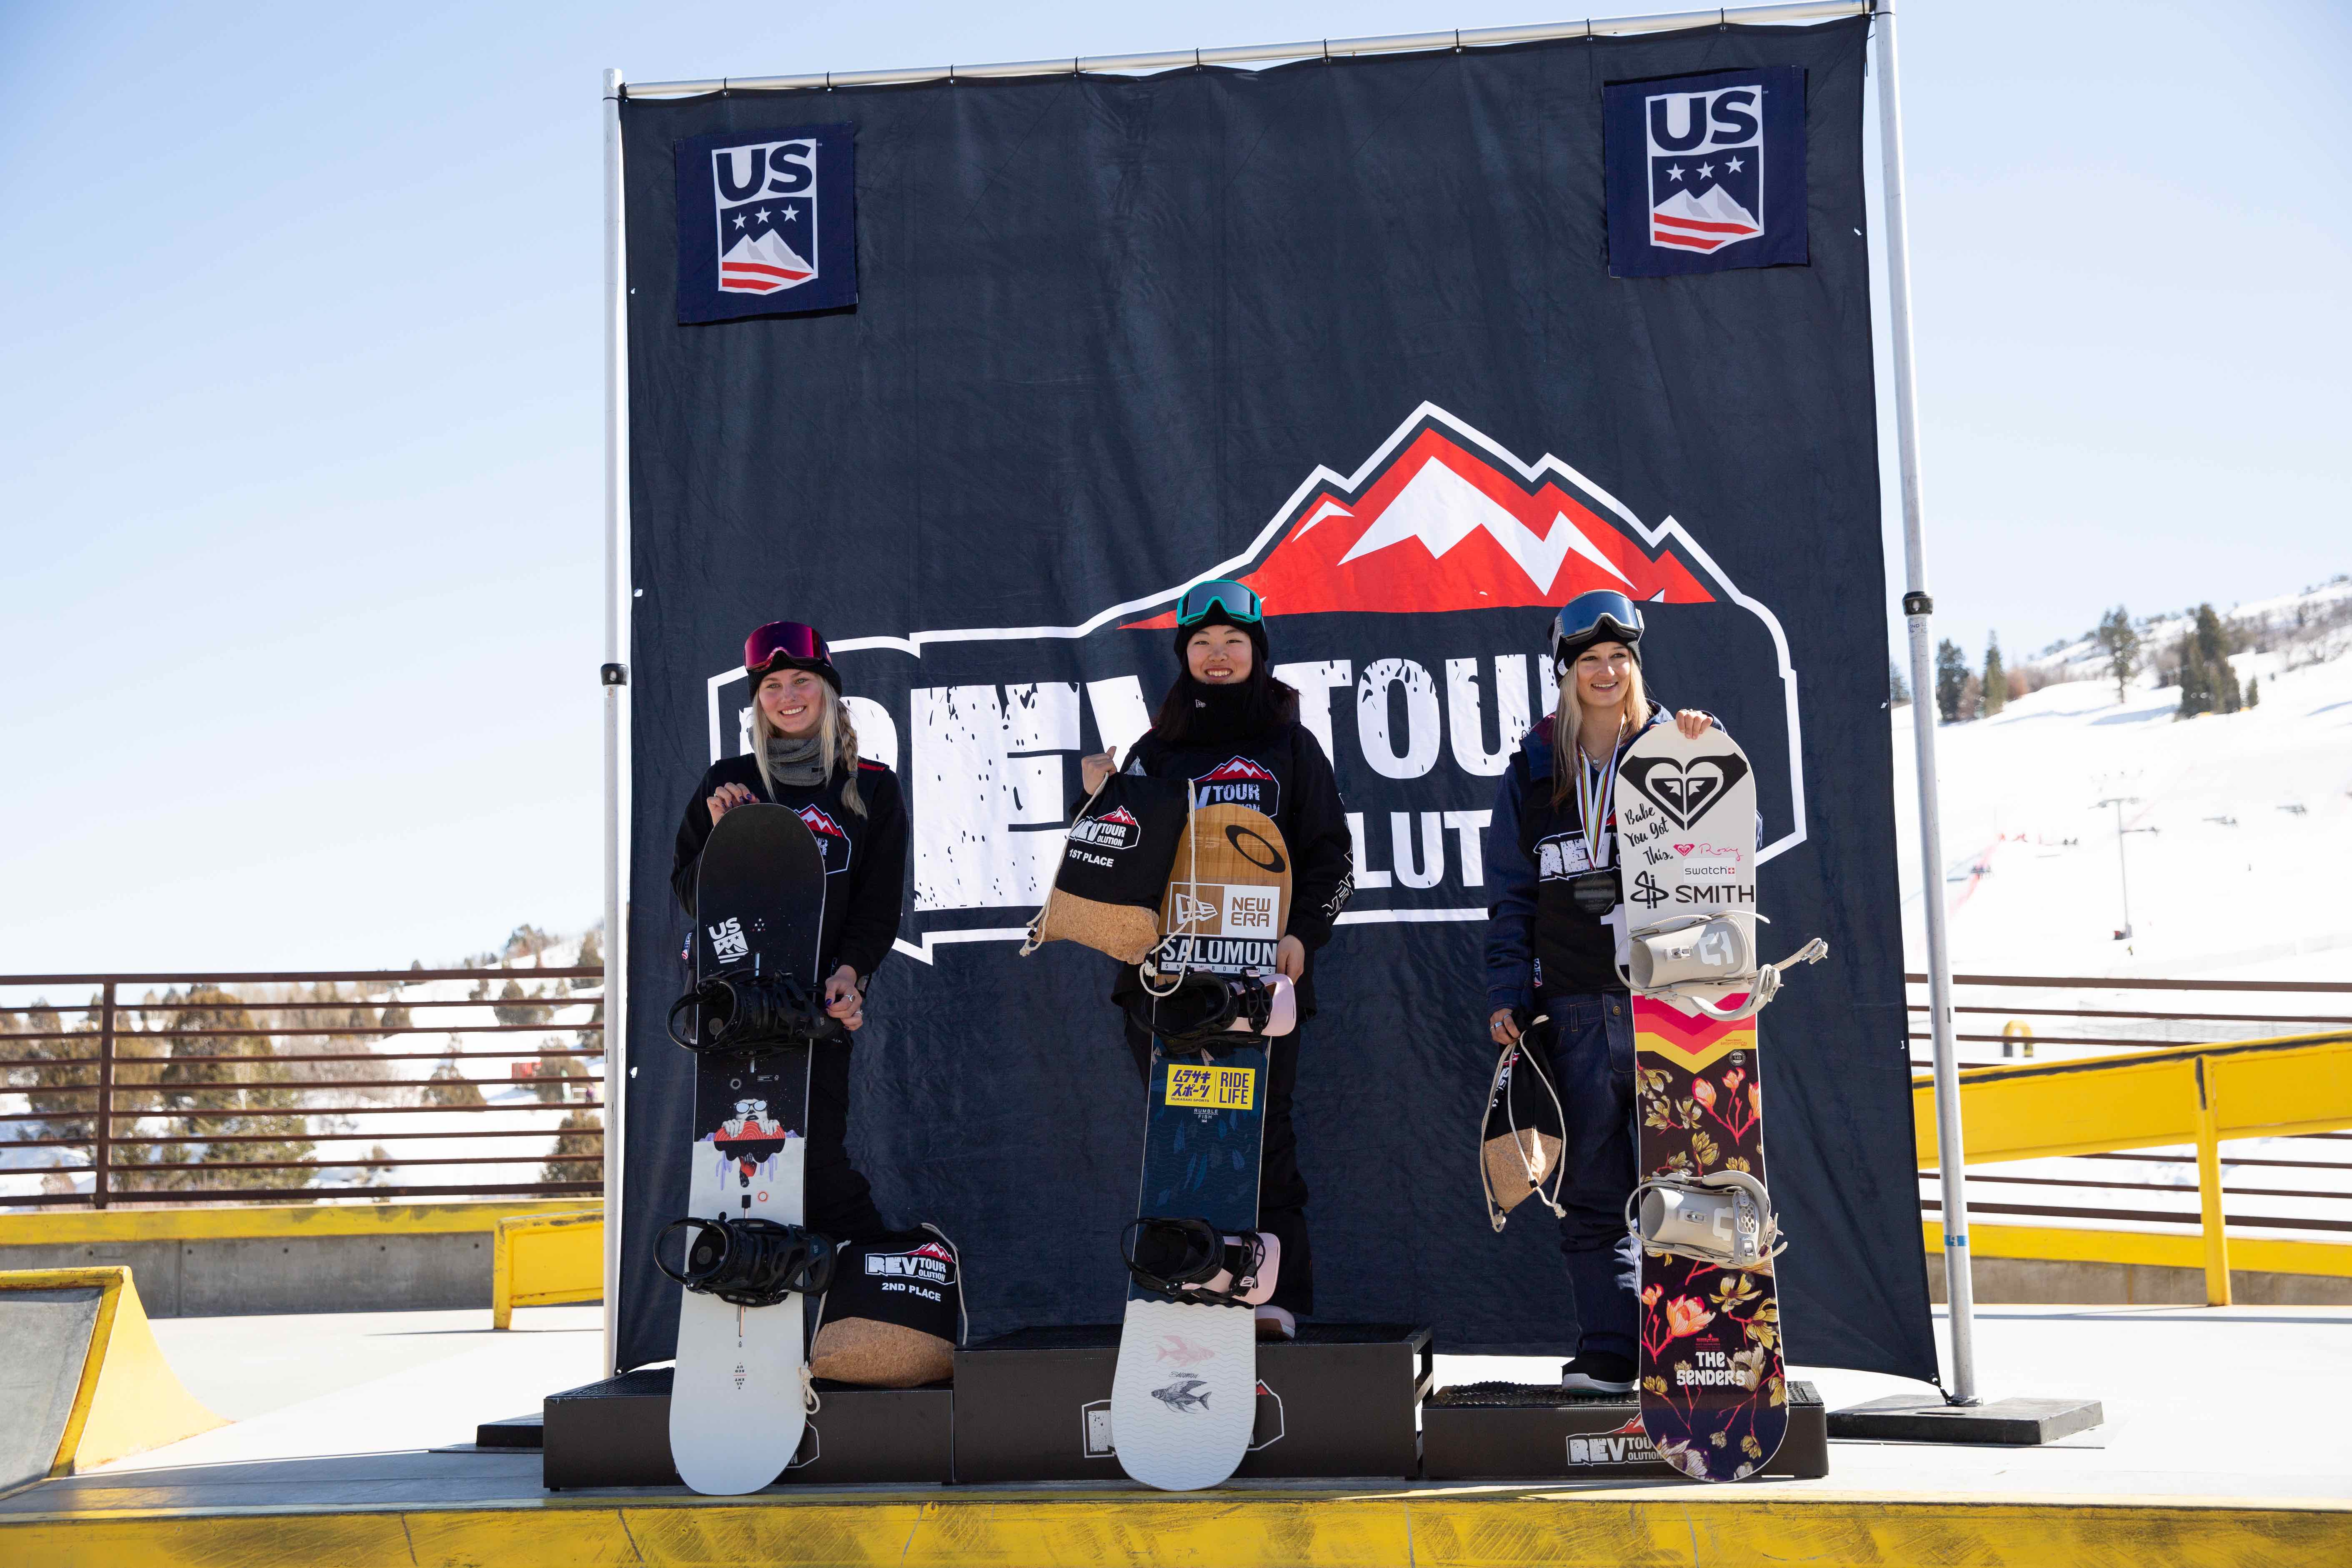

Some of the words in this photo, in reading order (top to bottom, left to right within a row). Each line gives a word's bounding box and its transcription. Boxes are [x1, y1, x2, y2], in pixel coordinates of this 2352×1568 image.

[1650, 90, 1759, 152] US
[716, 143, 813, 202] US
[1272, 654, 1559, 779] TOU
[1212, 783, 1260, 802] TOUR
[1624, 803, 1656, 825] Babe
[1101, 823, 1126, 838] TOUR
[1096, 835, 1123, 847] OLUTION
[1623, 833, 1649, 847] You
[1069, 848, 1083, 859] 1ST
[1083, 853, 1114, 868] PLACE
[1699, 843, 1744, 861] Roxy
[1684, 866, 1727, 875] swatch
[1675, 885, 1754, 903] SMITH
[1232, 896, 1271, 912] NEW
[708, 917, 741, 940] US
[1231, 912, 1270, 927] ERA
[1161, 938, 1277, 965] SALOMON
[1172, 1069, 1211, 1083] ムラサキ
[1220, 1072, 1250, 1088] RIDE
[1171, 1083, 1211, 1098] スポーツ
[1219, 1088, 1249, 1104] LIFE
[868, 1256, 919, 1275] REV
[918, 1257, 946, 1273] TOUR
[918, 1269, 946, 1282] OLUTION
[881, 1282, 906, 1291] 2ND
[908, 1285, 941, 1302] PLACE
[1569, 1438, 1626, 1462] REV
[1626, 1437, 1652, 1450] TOU
